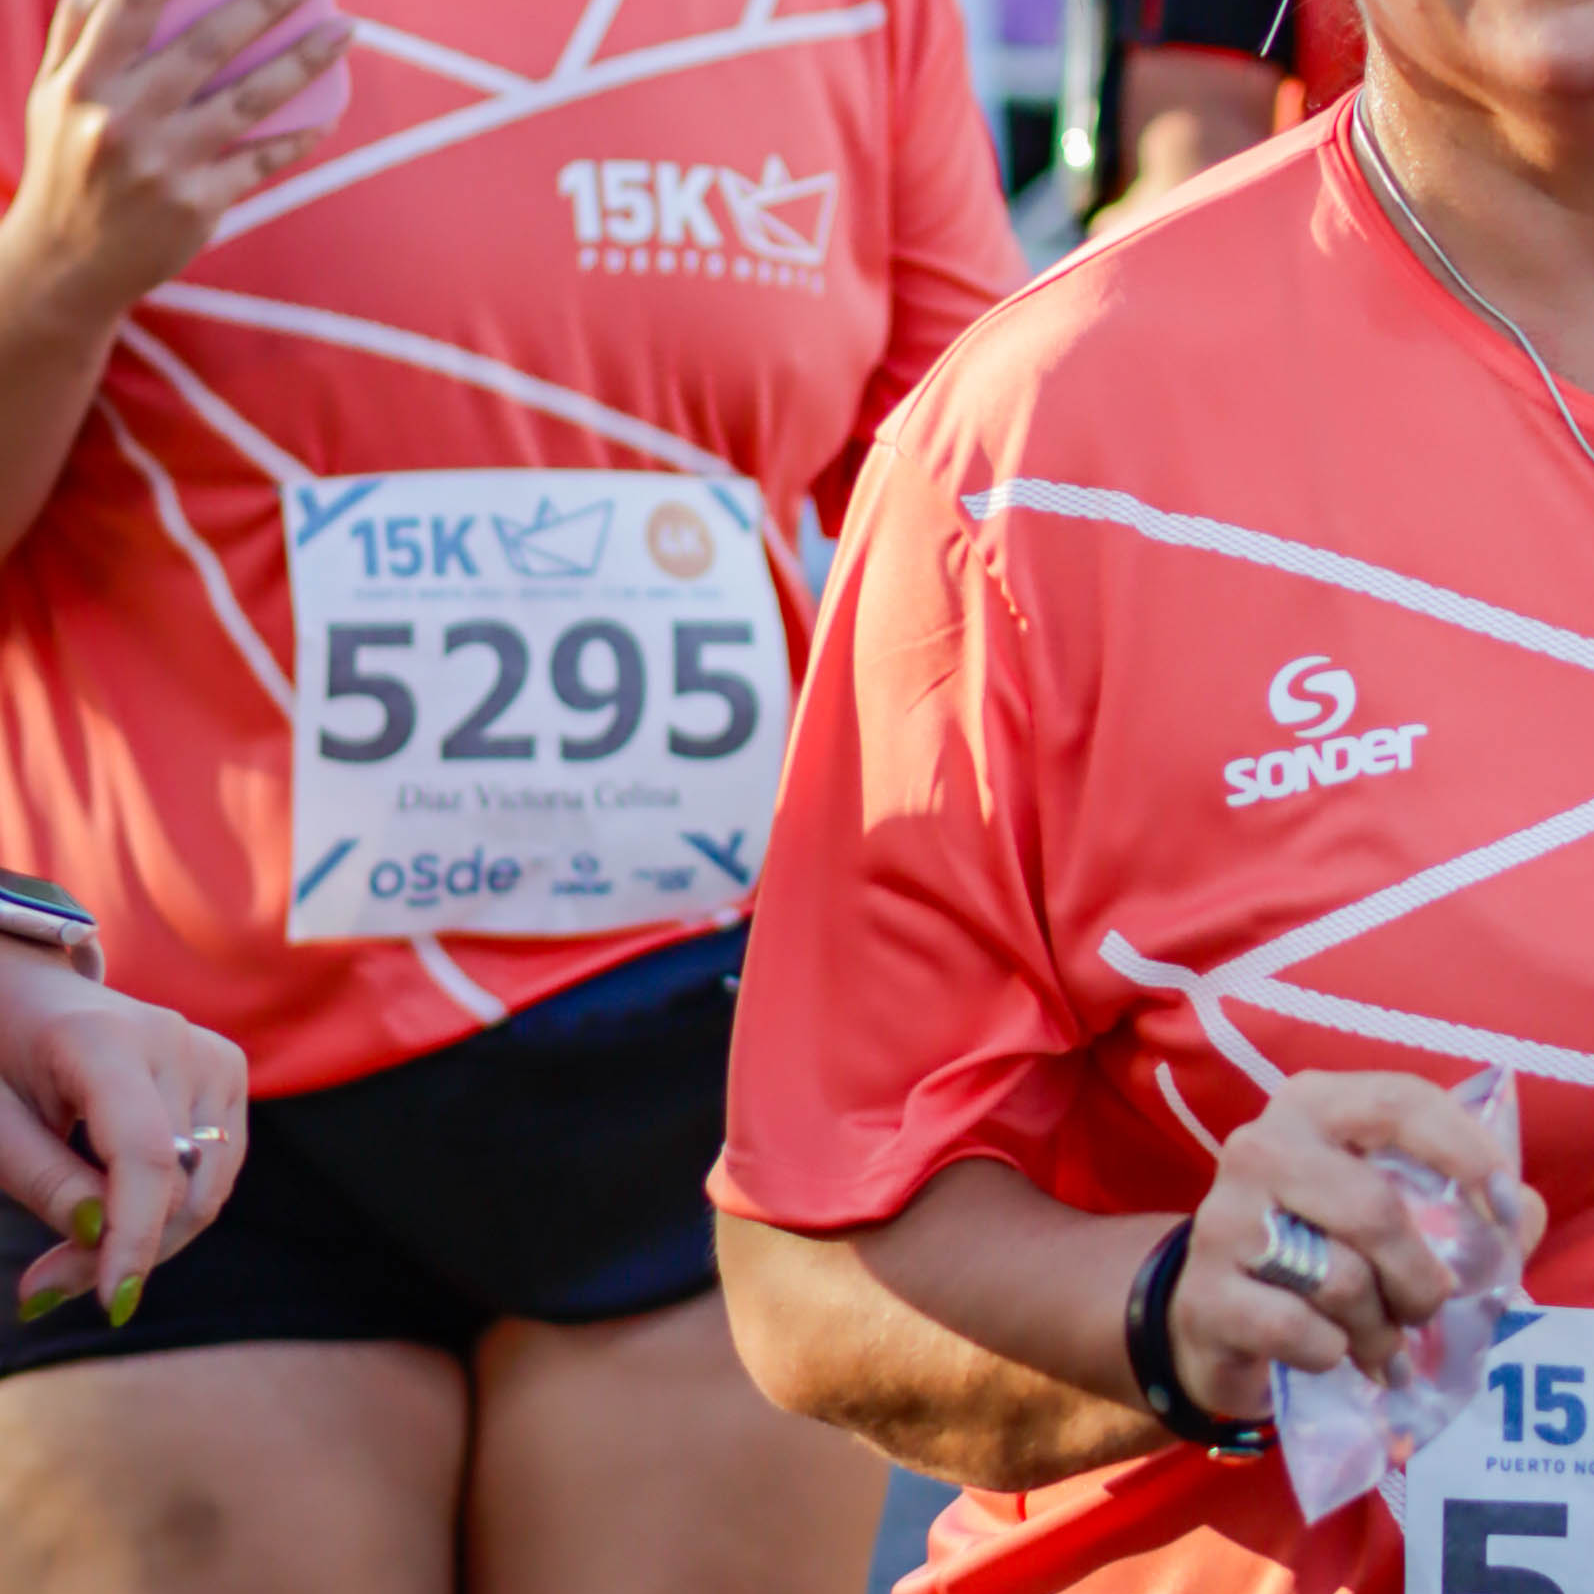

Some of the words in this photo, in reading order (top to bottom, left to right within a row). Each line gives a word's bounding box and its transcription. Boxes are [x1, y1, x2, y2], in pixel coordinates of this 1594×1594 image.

[556, 158, 724, 248] 15K
[350, 515, 480, 578] 15K
[317, 616, 761, 764] 5295
[368, 845, 523, 899] osde
[1485, 1456, 1566, 1474] PUERTO
